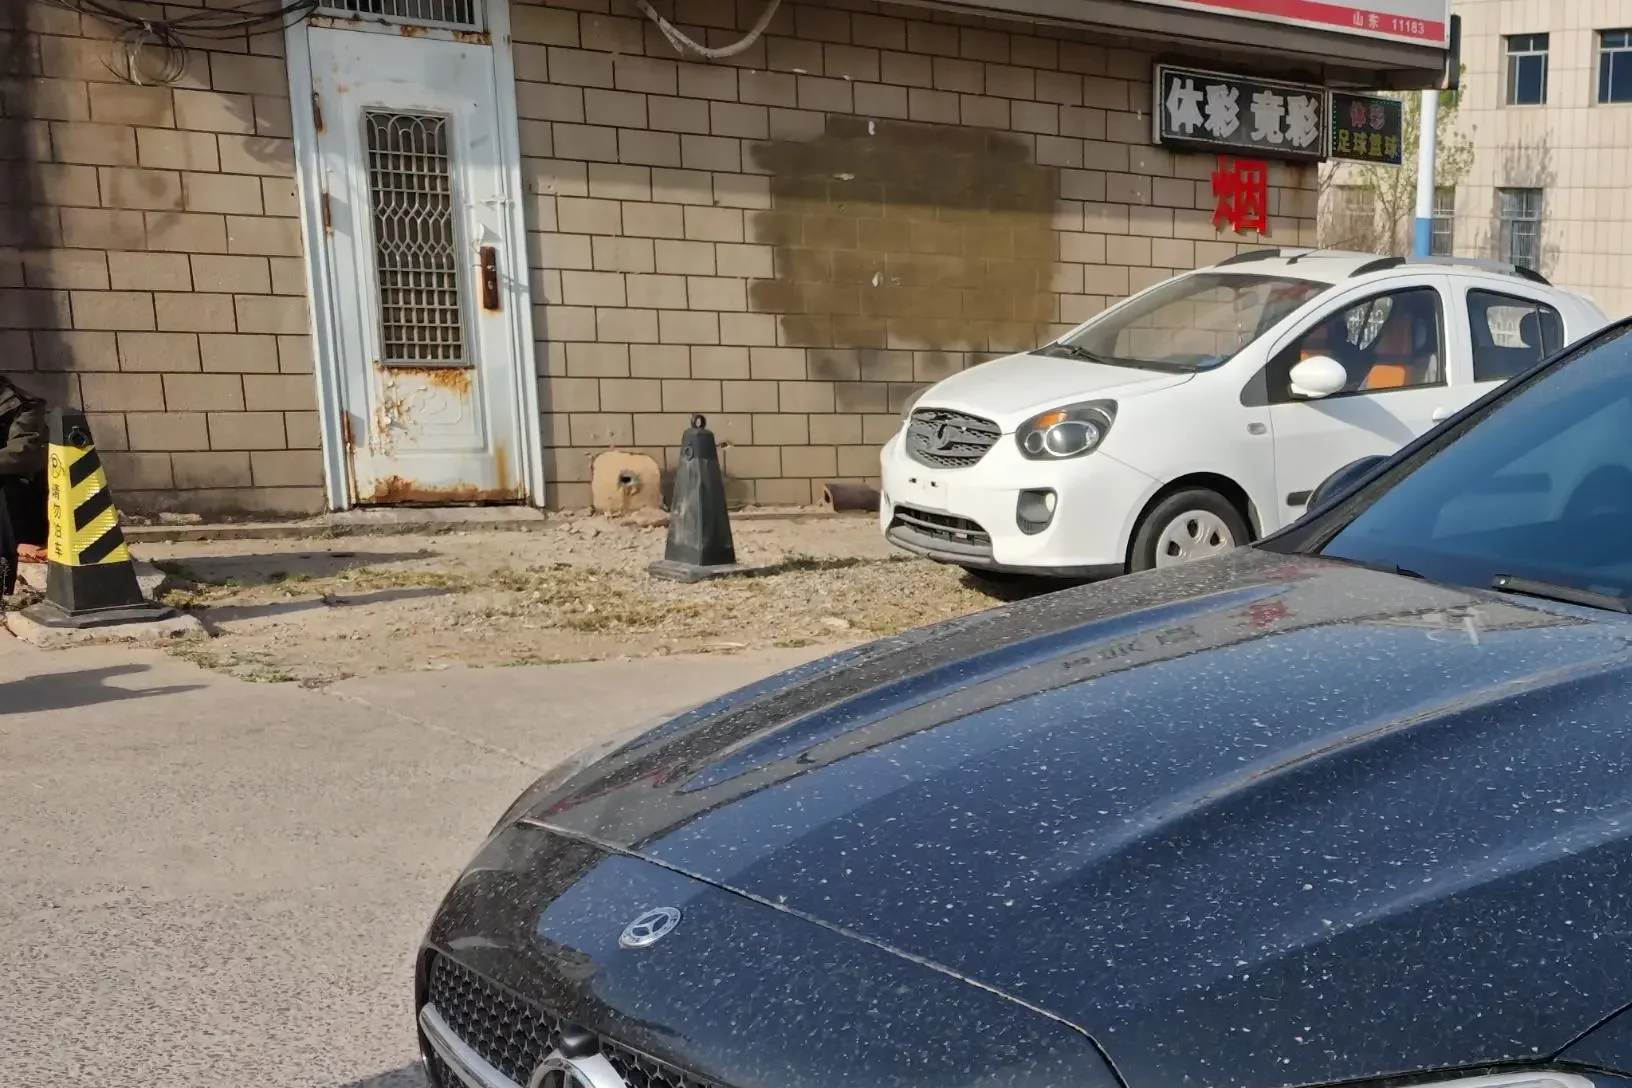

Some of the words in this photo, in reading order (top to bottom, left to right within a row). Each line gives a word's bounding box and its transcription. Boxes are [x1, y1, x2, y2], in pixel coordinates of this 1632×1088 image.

[1353, 11, 1380, 29] 山东
[1392, 18, 1425, 34] 11183
[1166, 77, 1240, 138] 体彩
[1211, 154, 1268, 236] 烟
